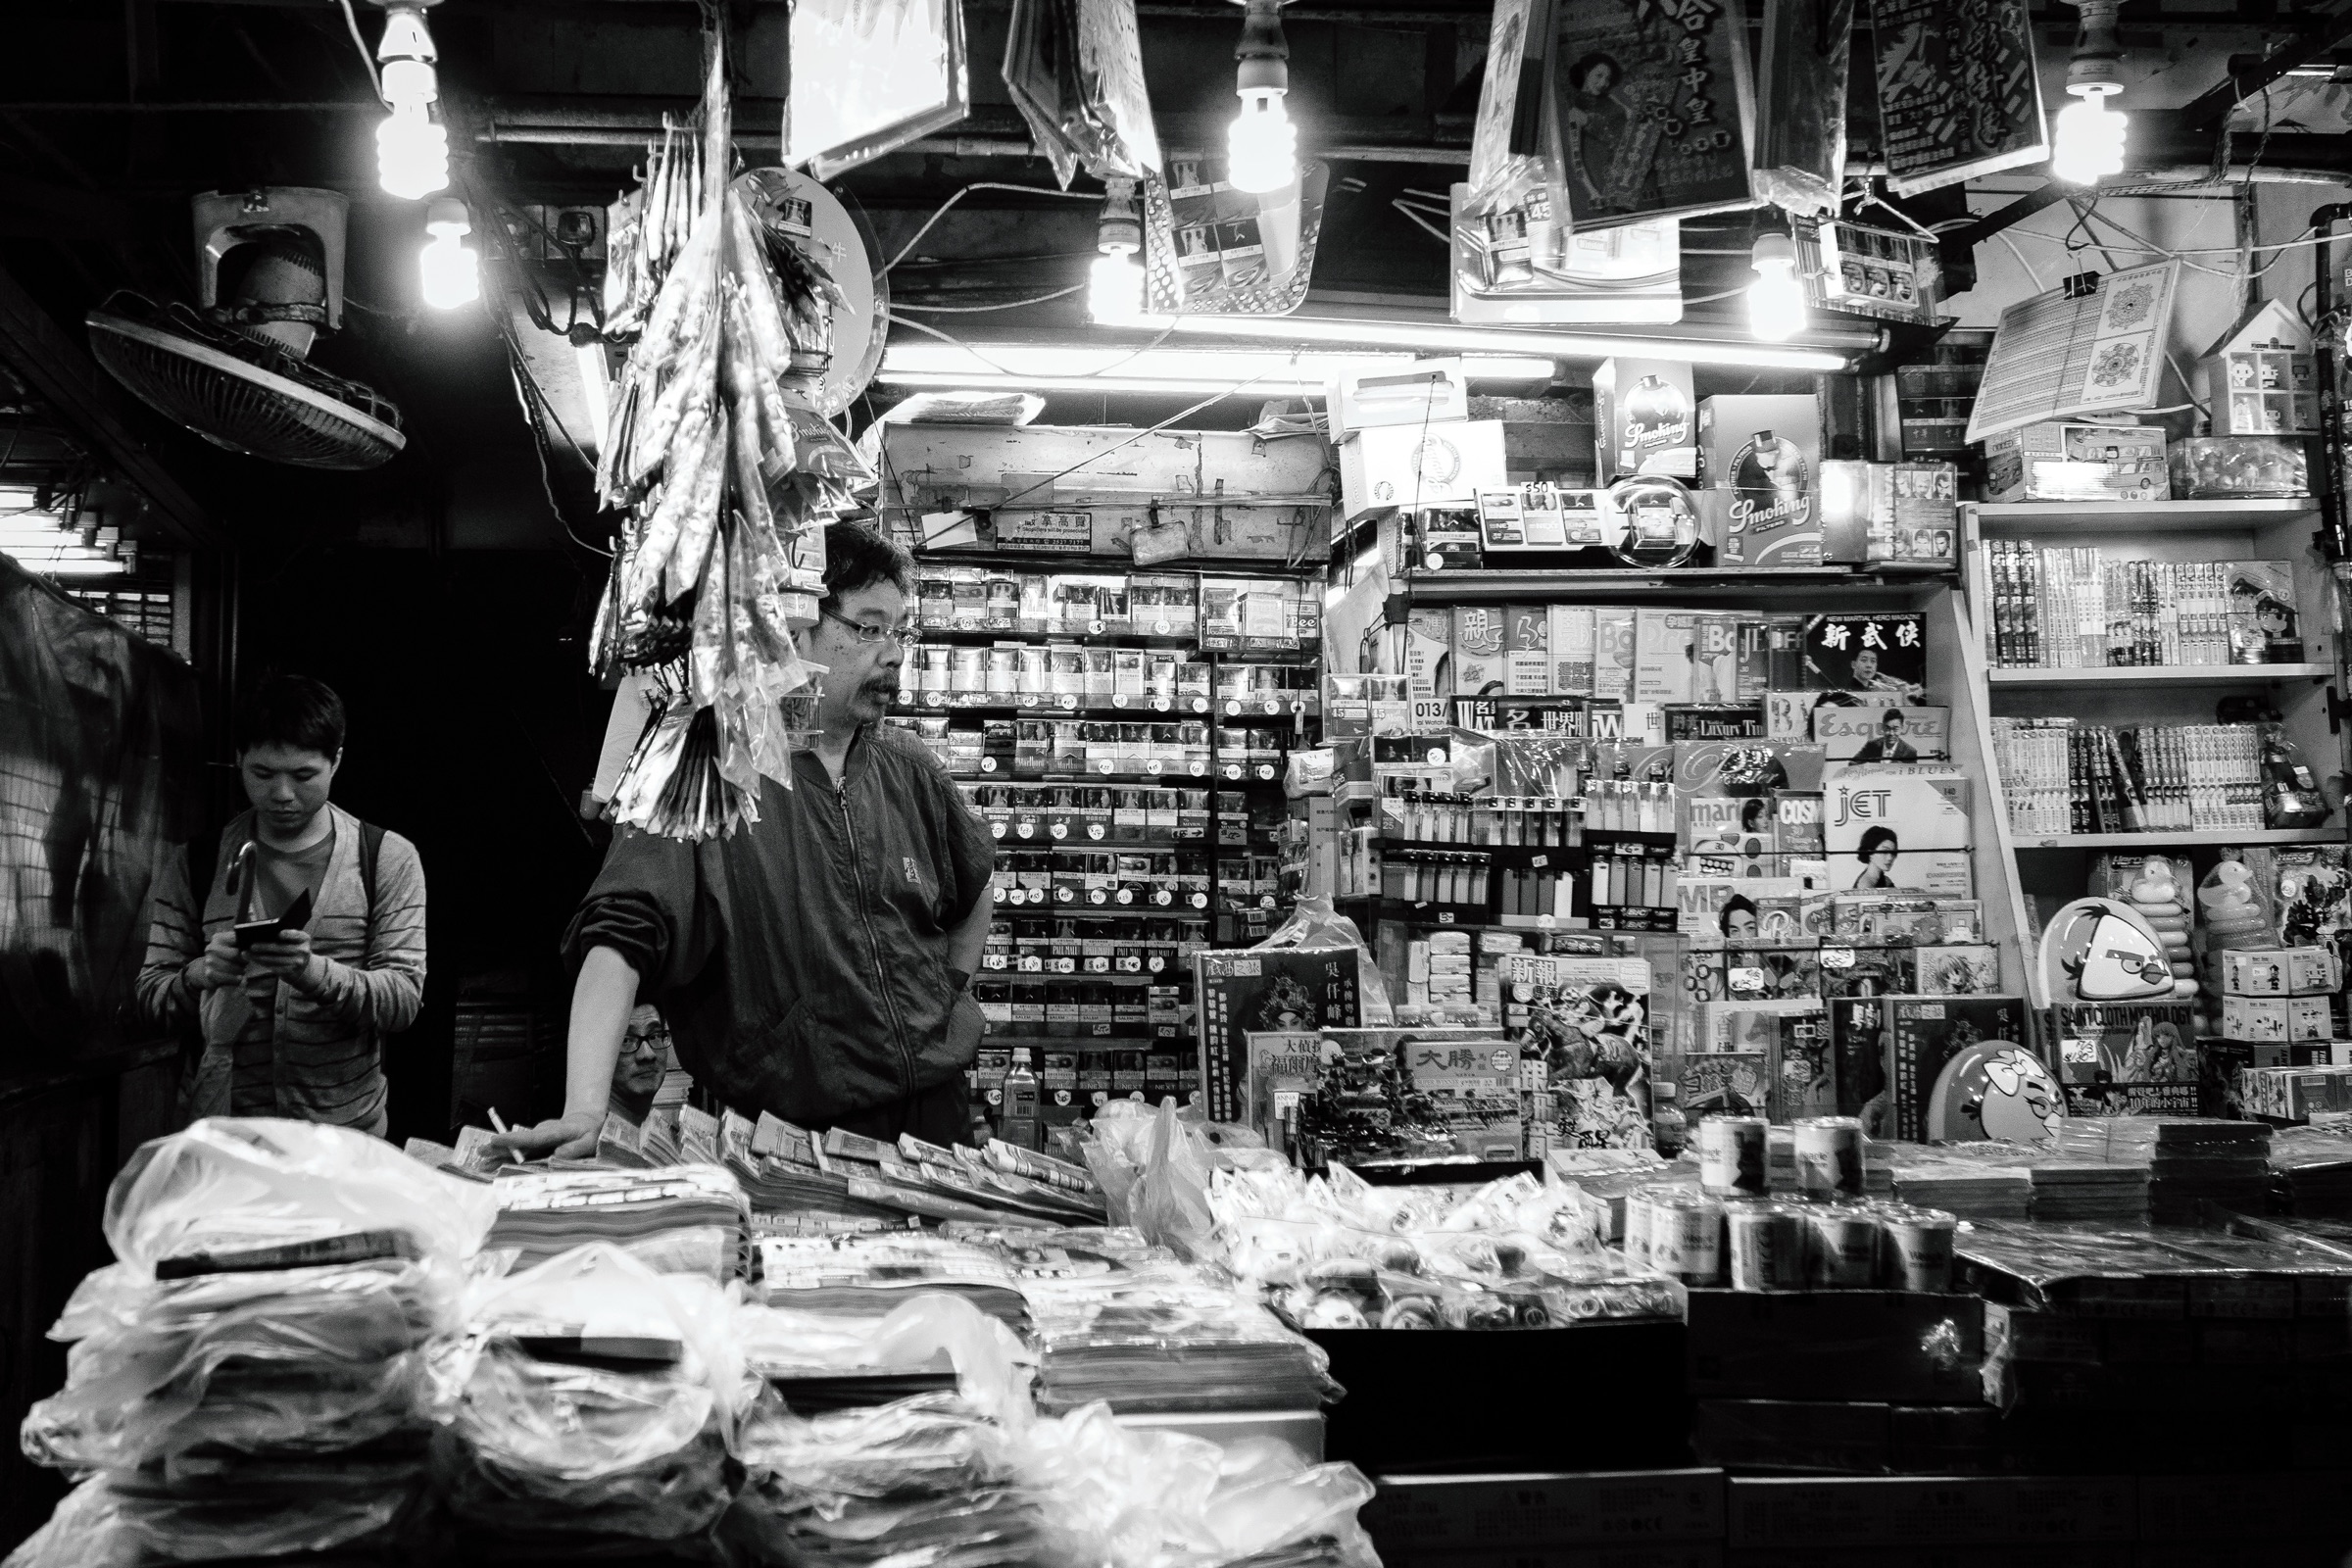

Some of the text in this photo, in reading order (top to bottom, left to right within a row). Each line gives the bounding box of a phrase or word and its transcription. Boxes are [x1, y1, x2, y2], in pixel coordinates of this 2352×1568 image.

[1624, 420, 1690, 447] Smoking
[1525, 481, 1548, 493] $50
[1728, 494, 1813, 534] Smoking
[1372, 709, 1386, 718] 45
[1700, 719, 1740, 737] Luxury
[1819, 712, 1942, 741] Esqre
[1907, 766, 1956, 775] BLUES
[1511, 956, 1557, 986] 新報
[2094, 1006, 2127, 1026] CLOTH
[1416, 1048, 1476, 1071] 大勝
